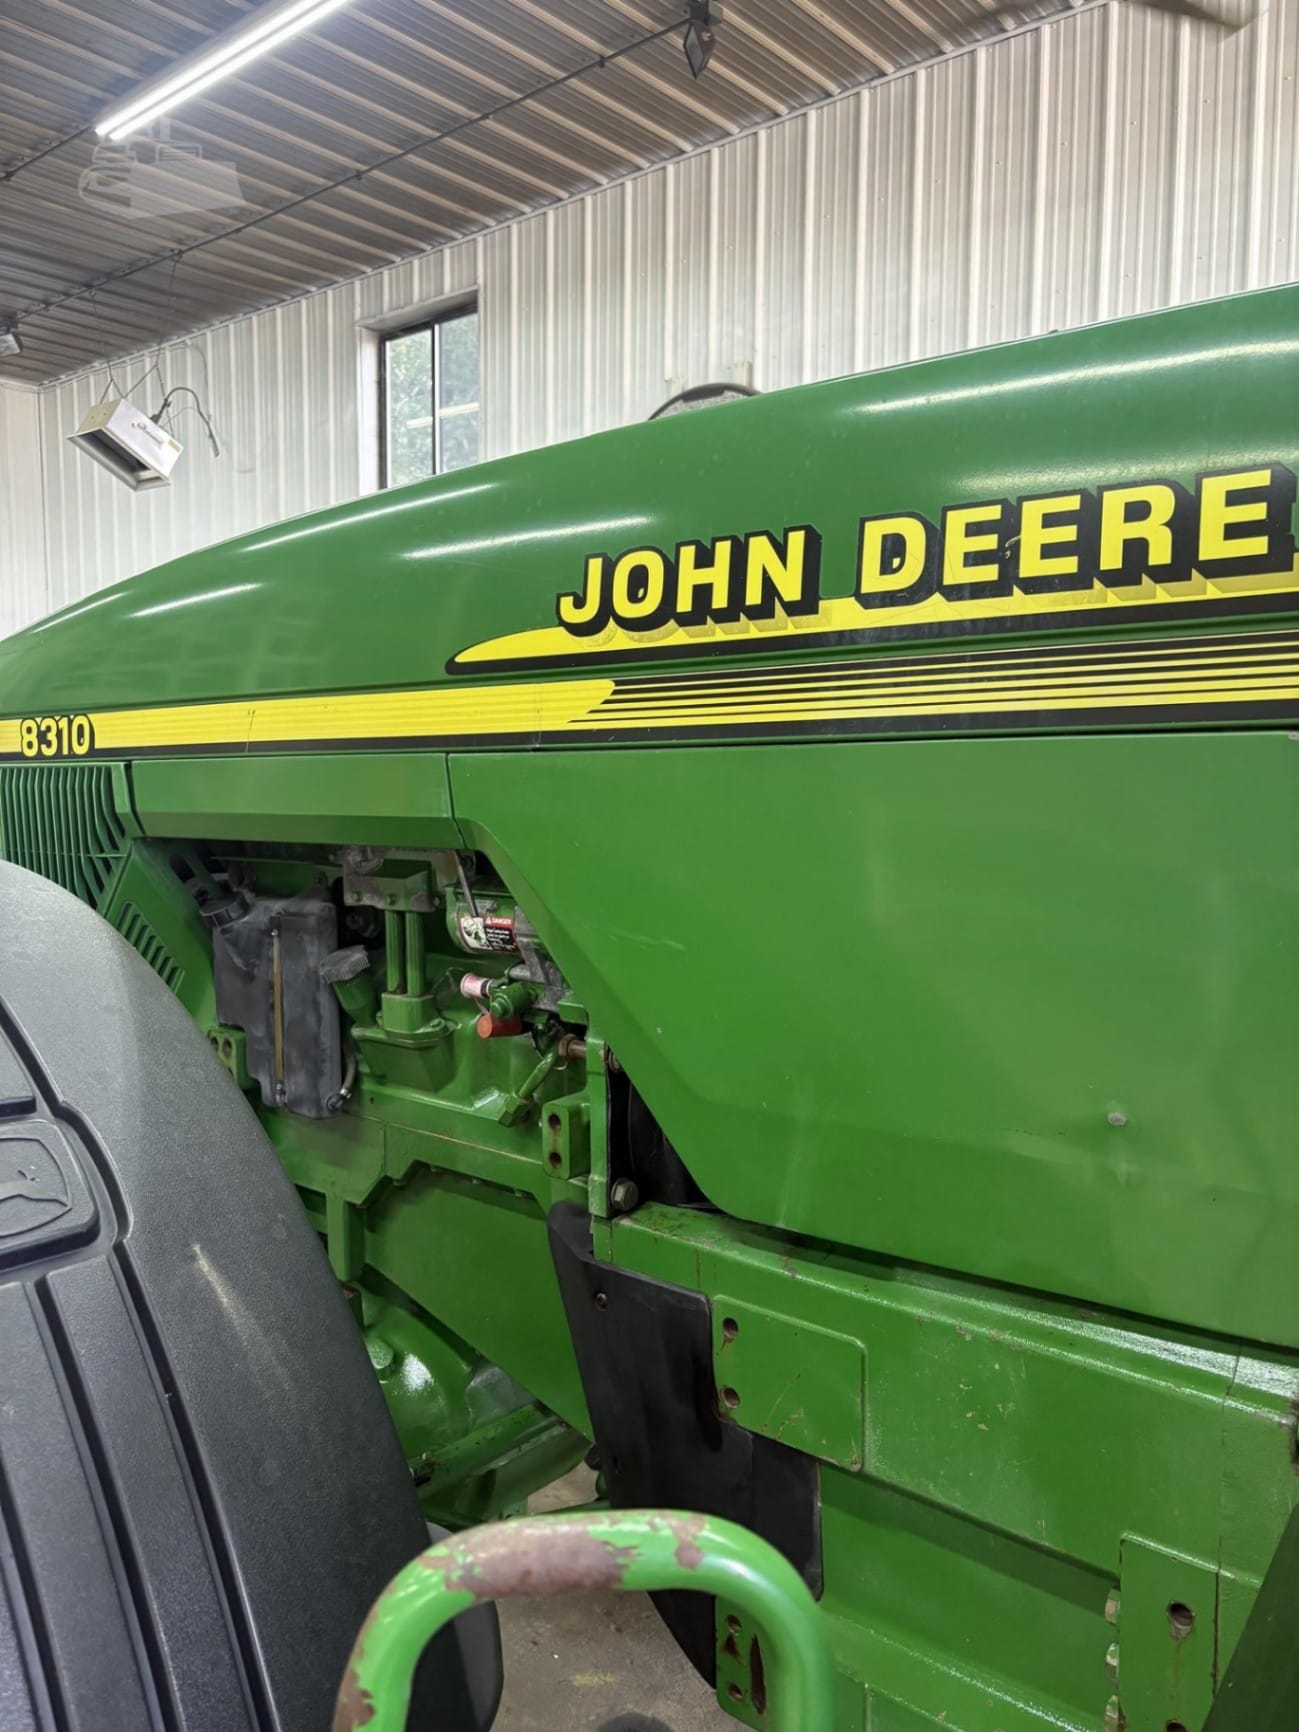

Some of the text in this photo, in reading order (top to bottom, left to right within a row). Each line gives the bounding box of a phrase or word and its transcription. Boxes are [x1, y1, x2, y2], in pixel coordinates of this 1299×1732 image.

[559, 468, 1272, 625] JOHN DEERE
[21, 714, 90, 757] 8310
